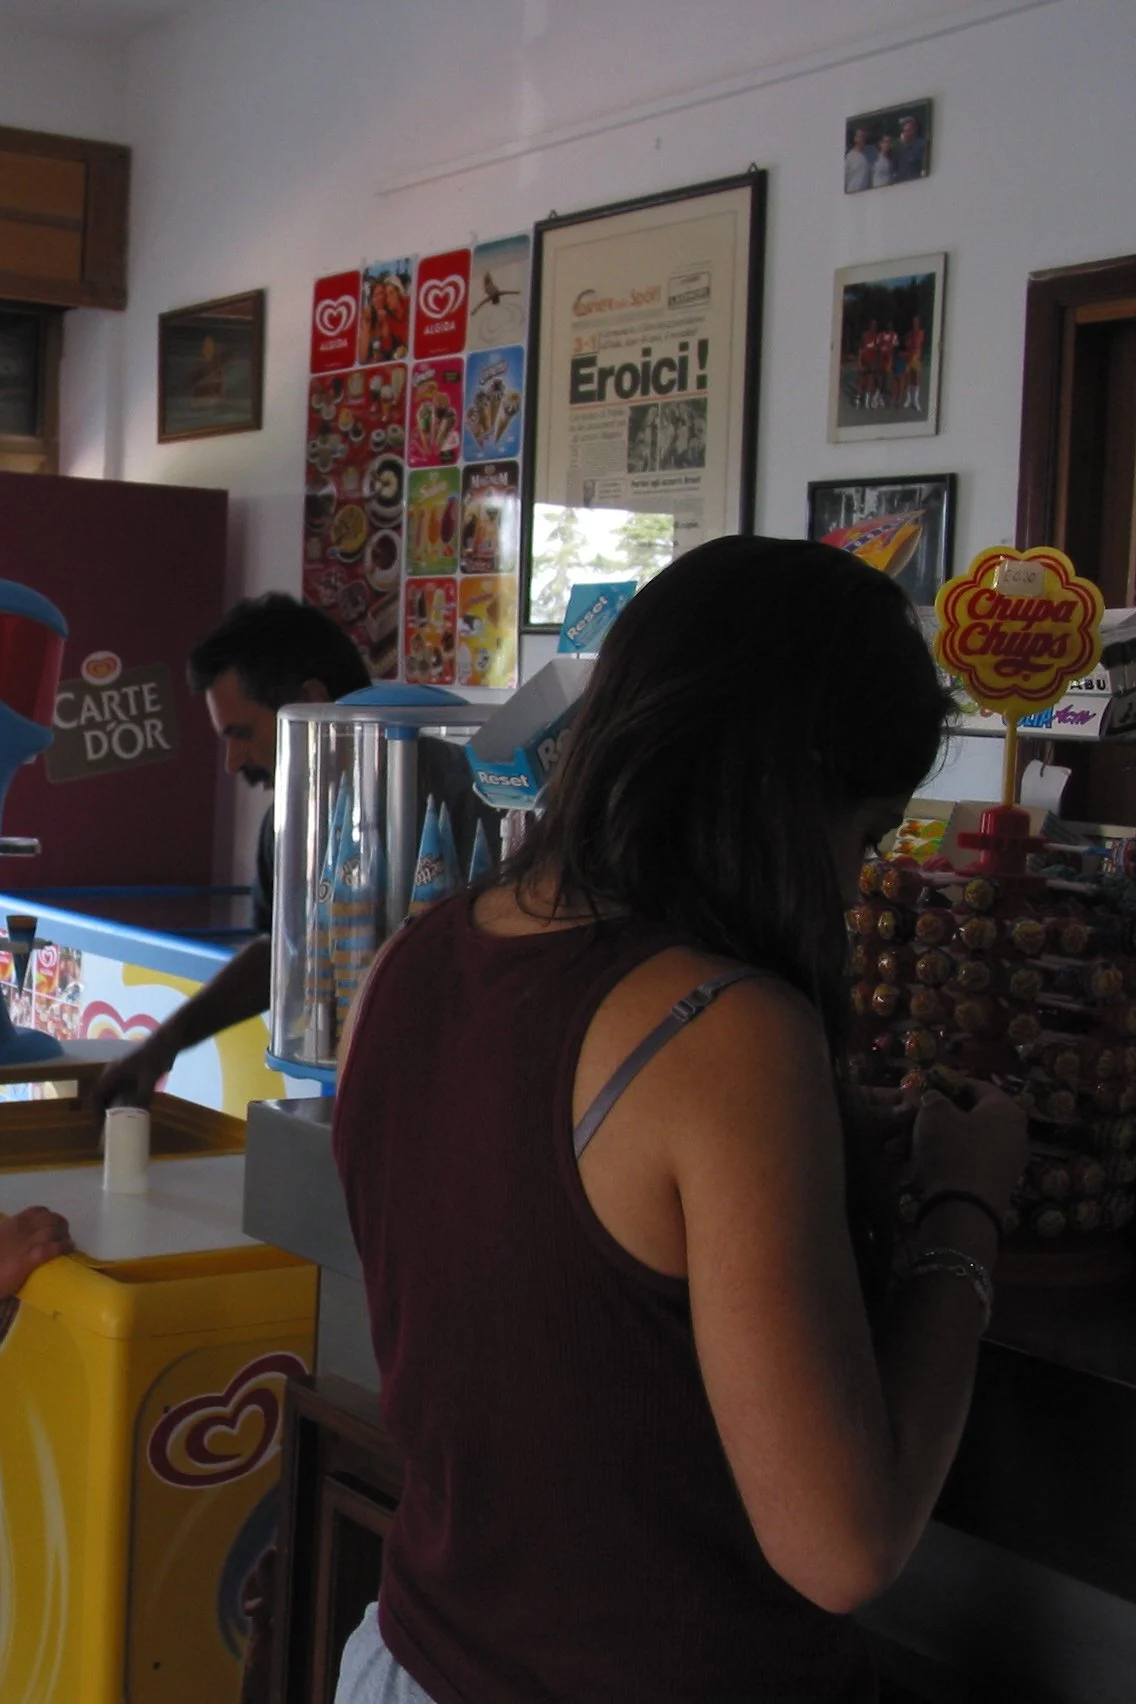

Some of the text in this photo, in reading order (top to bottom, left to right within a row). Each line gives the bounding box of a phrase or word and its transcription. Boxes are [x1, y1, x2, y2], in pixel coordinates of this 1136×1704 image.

[567, 594, 609, 641] Reset
[967, 588, 1079, 629] Chupa
[958, 622, 1071, 662] Chups
[53, 682, 163, 729] CARTE
[83, 718, 171, 761] D'OR
[477, 770, 530, 788] Reset
